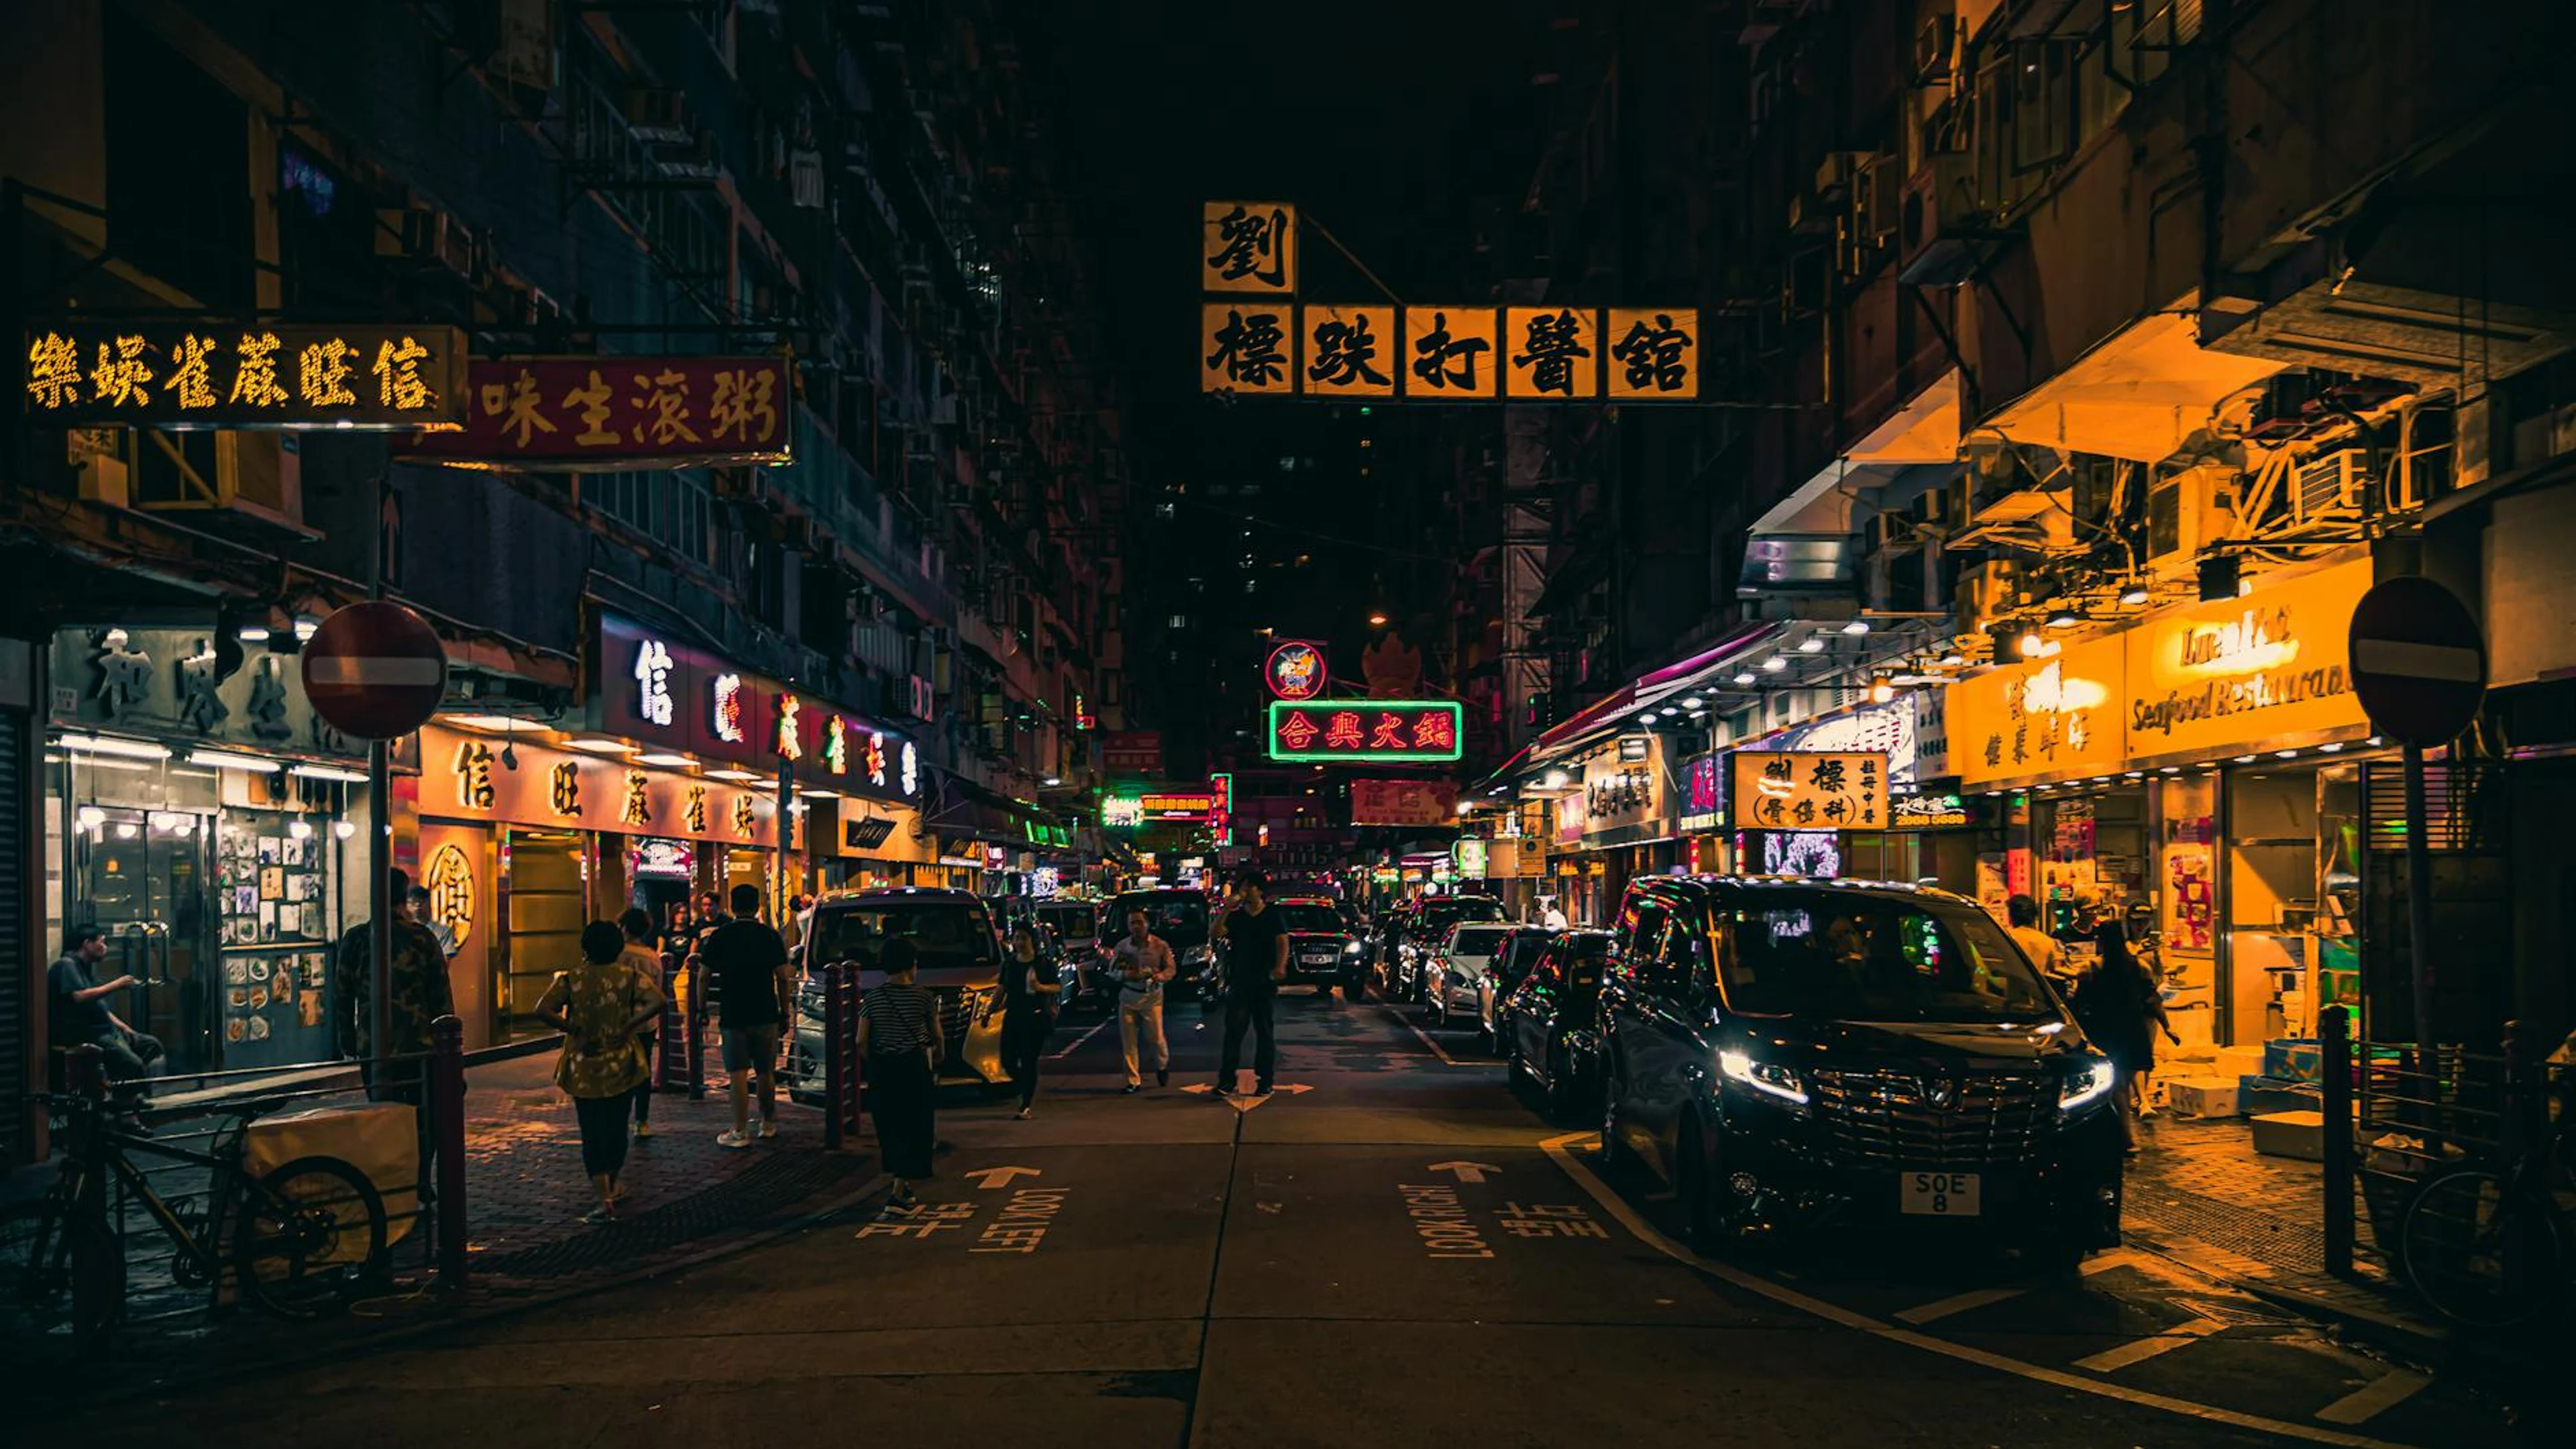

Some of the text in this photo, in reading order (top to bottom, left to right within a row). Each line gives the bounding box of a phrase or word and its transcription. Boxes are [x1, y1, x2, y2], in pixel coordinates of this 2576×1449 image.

[1209, 207, 1287, 288] 劉
[411, 367, 777, 448] 味生滾粥
[1277, 710, 1454, 750] 合興火鍋
[2132, 680, 2213, 736] Seafood
[2218, 665, 2356, 716] Restauran
[965, 1187, 1071, 1253] LOOK LEFT
[1397, 1183, 1496, 1258] LOOK RIGHT
[1933, 1193, 1947, 1213] 8
